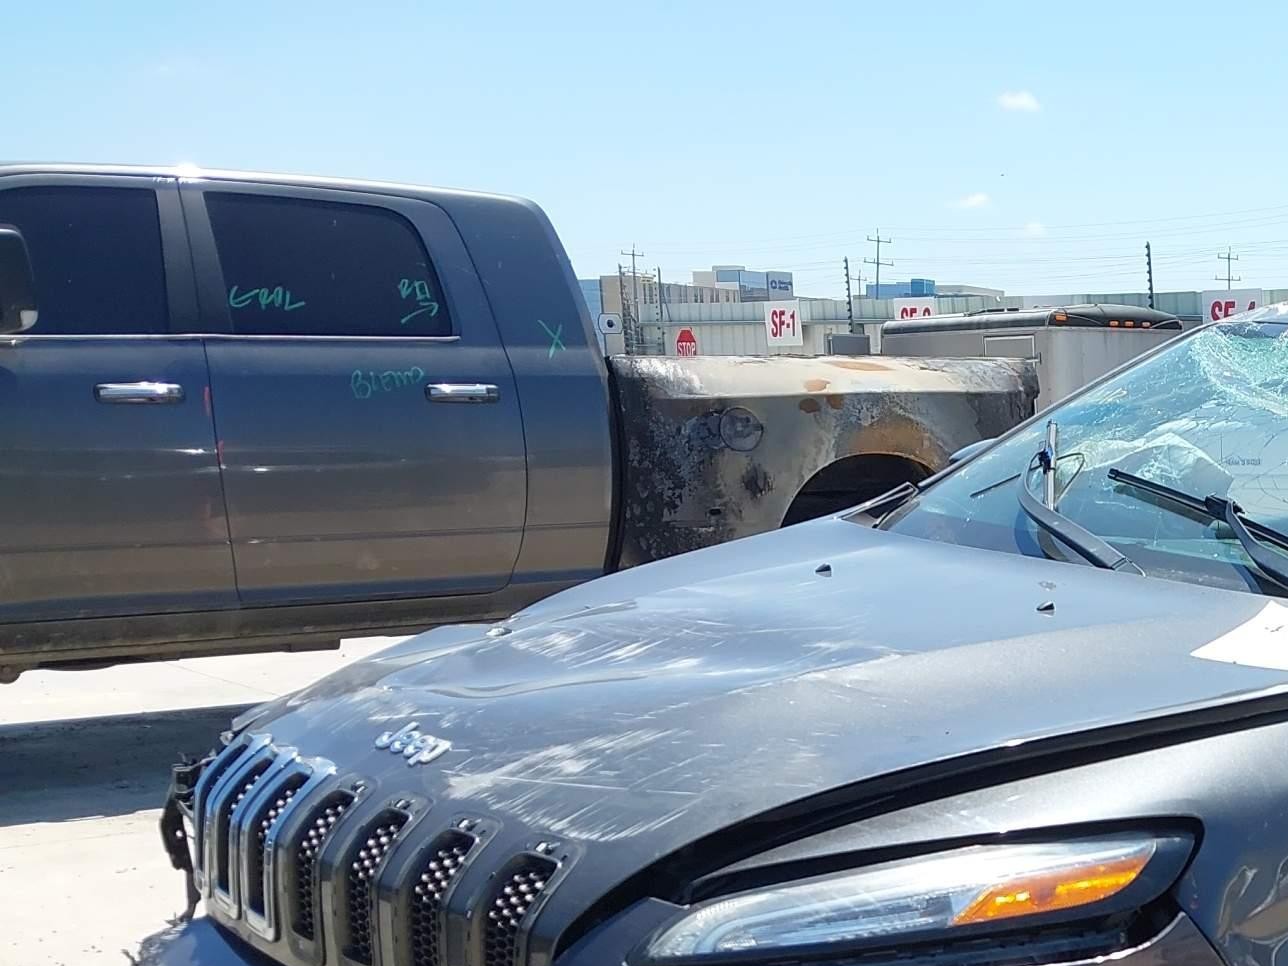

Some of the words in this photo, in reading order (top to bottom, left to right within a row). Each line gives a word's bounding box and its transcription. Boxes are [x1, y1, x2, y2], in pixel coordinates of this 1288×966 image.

[771, 309, 796, 337] SF-1
[677, 341, 696, 356] STOP
[375, 721, 452, 766] Jeep
